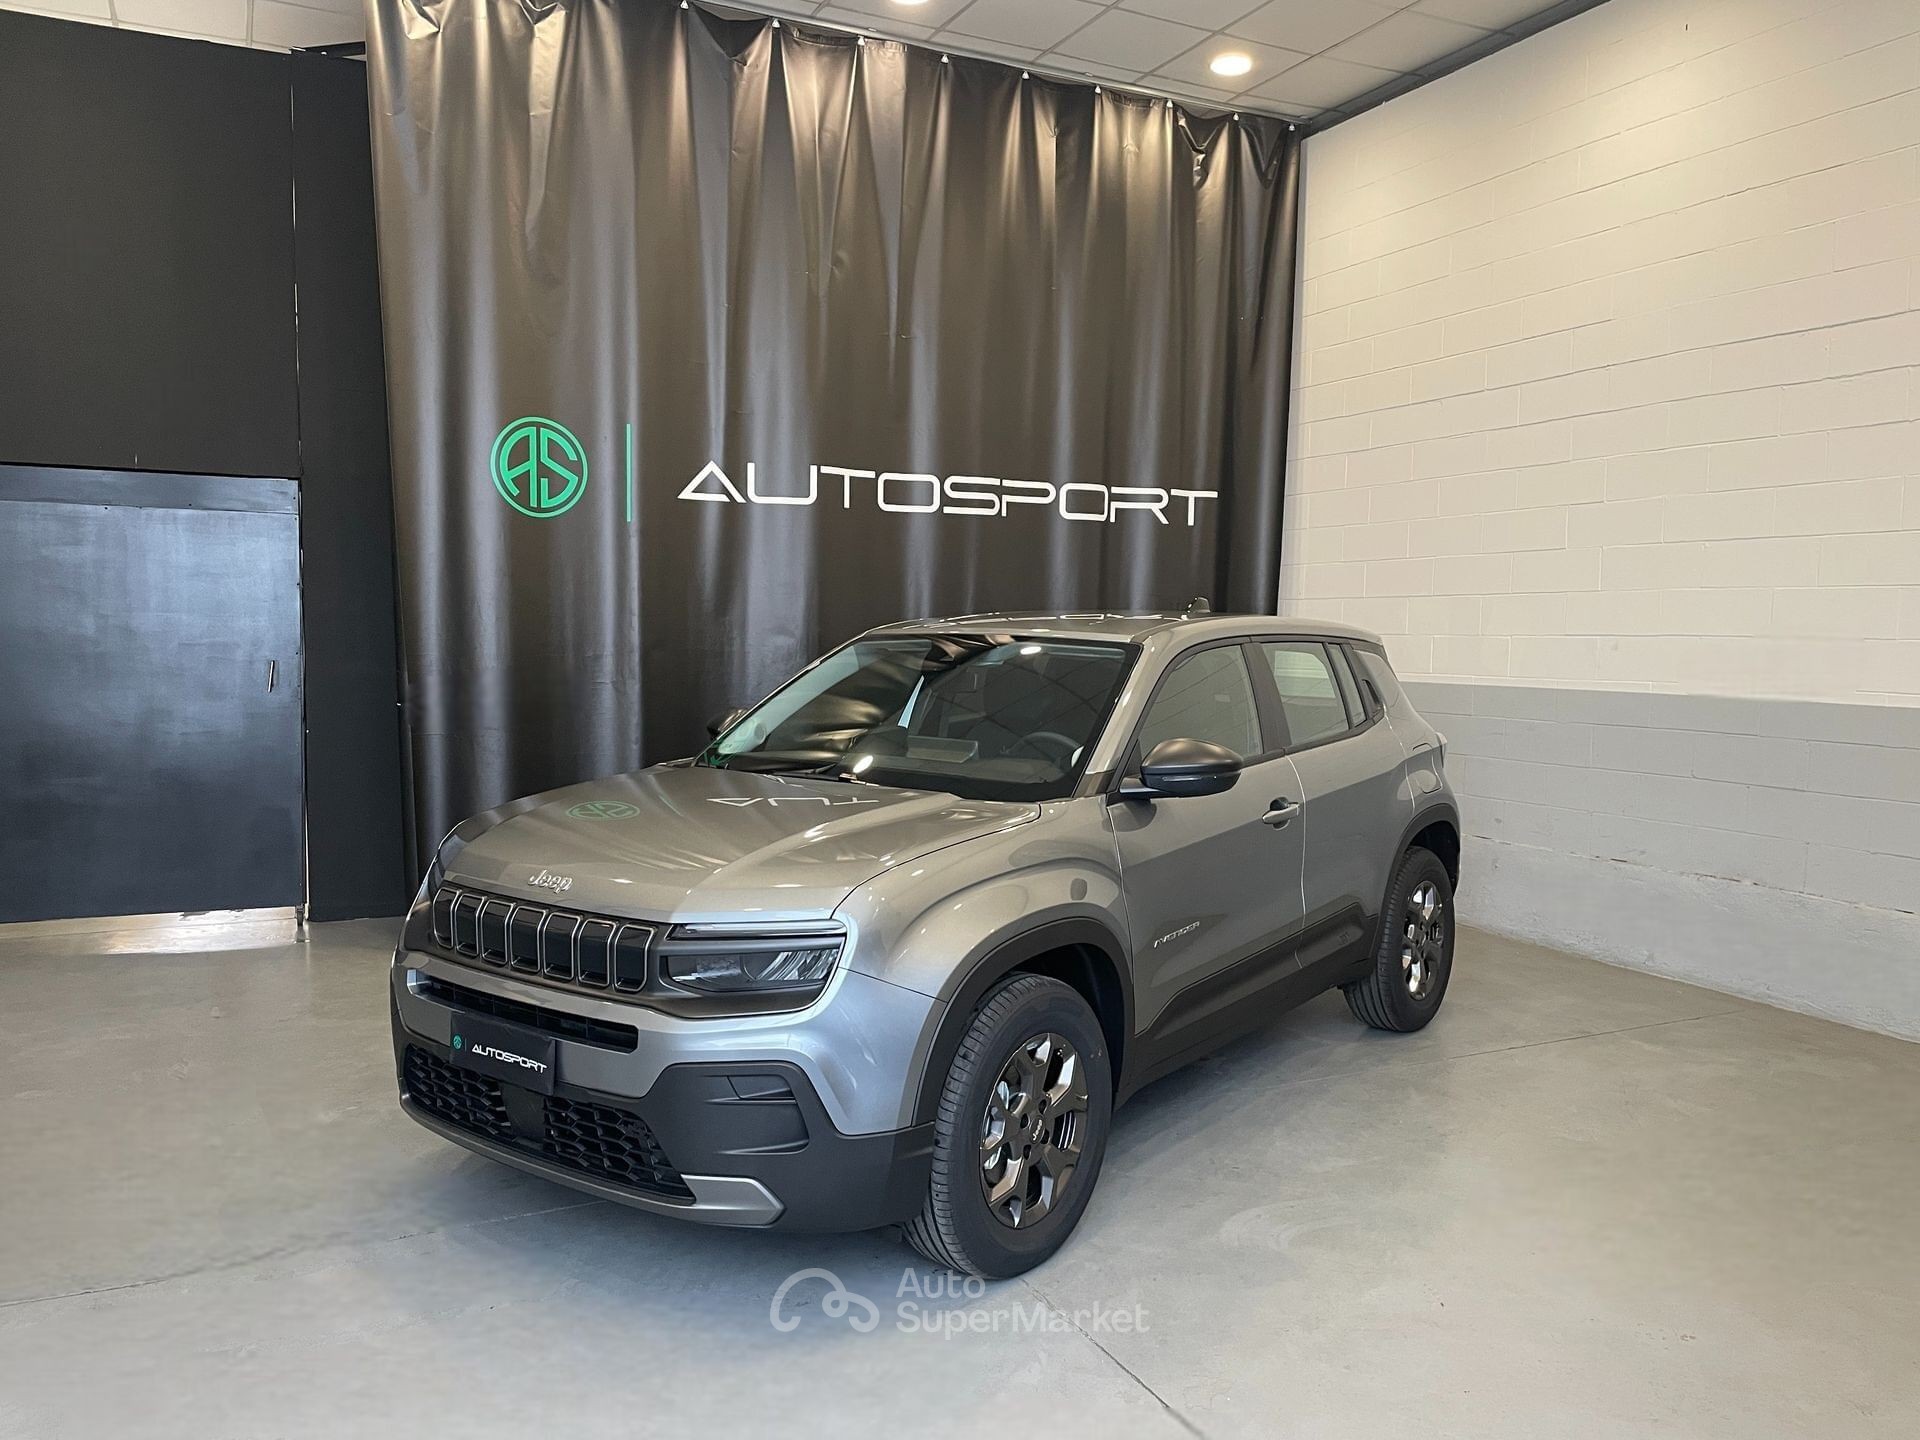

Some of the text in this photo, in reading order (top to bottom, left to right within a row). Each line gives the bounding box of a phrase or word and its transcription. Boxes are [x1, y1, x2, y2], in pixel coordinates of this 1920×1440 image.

[677, 460, 1218, 526] AUTOSPORT
[528, 870, 573, 894] Jeep
[472, 1044, 547, 1073] AUTOSPORT
